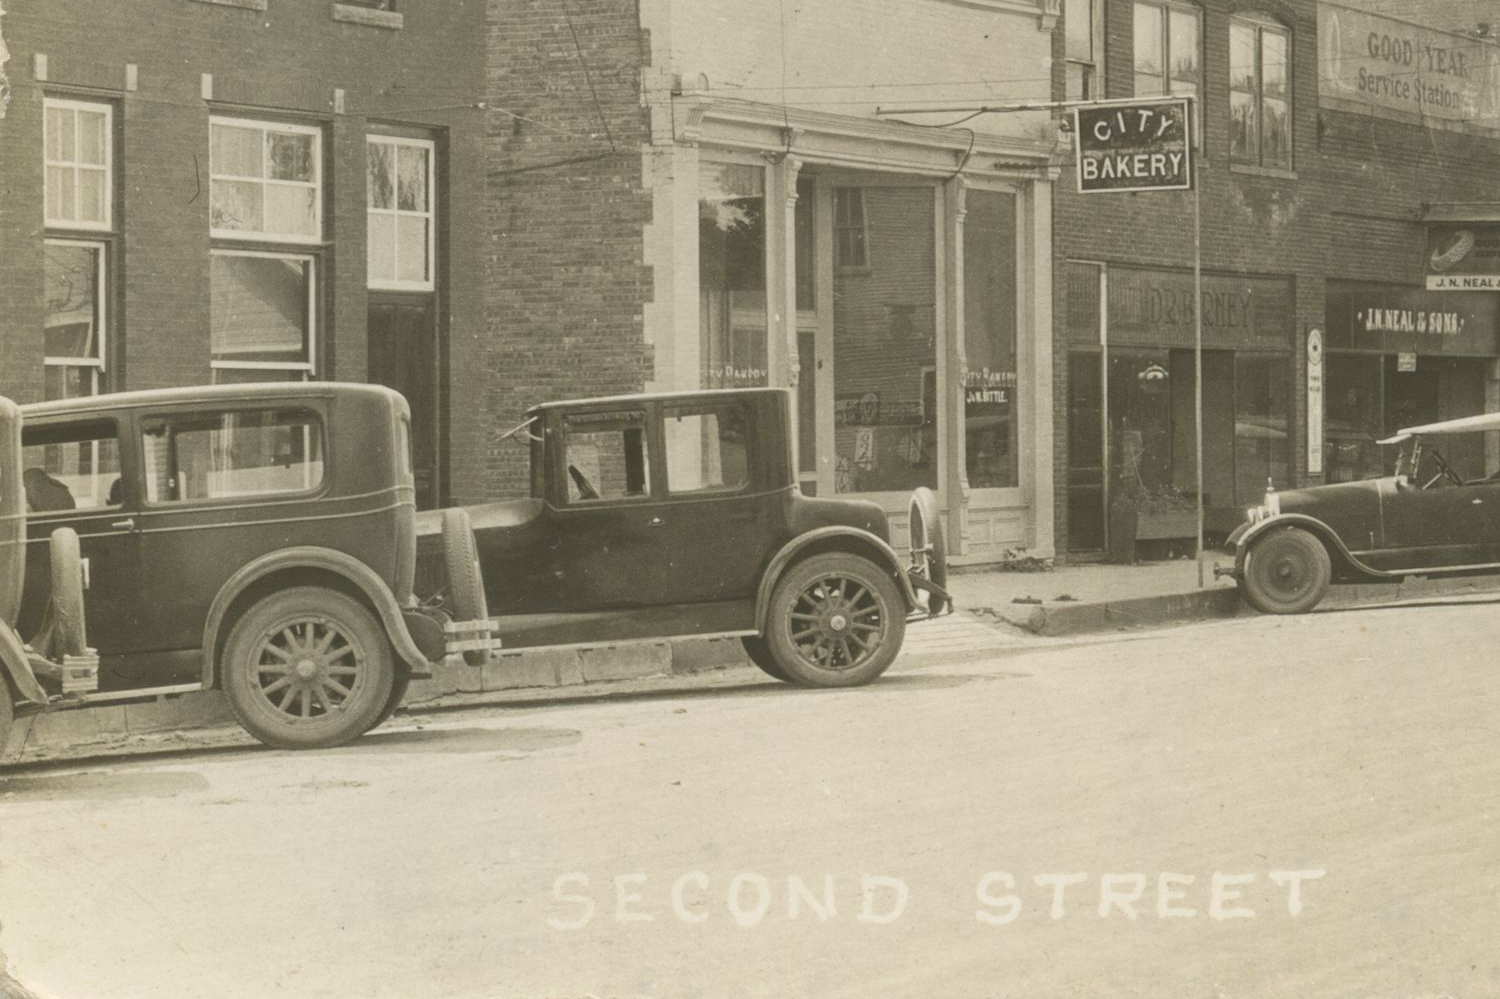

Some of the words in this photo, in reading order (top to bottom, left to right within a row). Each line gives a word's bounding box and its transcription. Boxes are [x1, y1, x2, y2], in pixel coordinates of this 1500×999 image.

[1367, 31, 1412, 67] GOOD
[1358, 66, 1410, 99] Service
[1414, 78, 1460, 109] Station
[1094, 111, 1174, 141] CITY
[1083, 153, 1182, 180] BAKERY
[1463, 278, 1494, 288] NEAL
[1183, 290, 1251, 328] BRNEY
